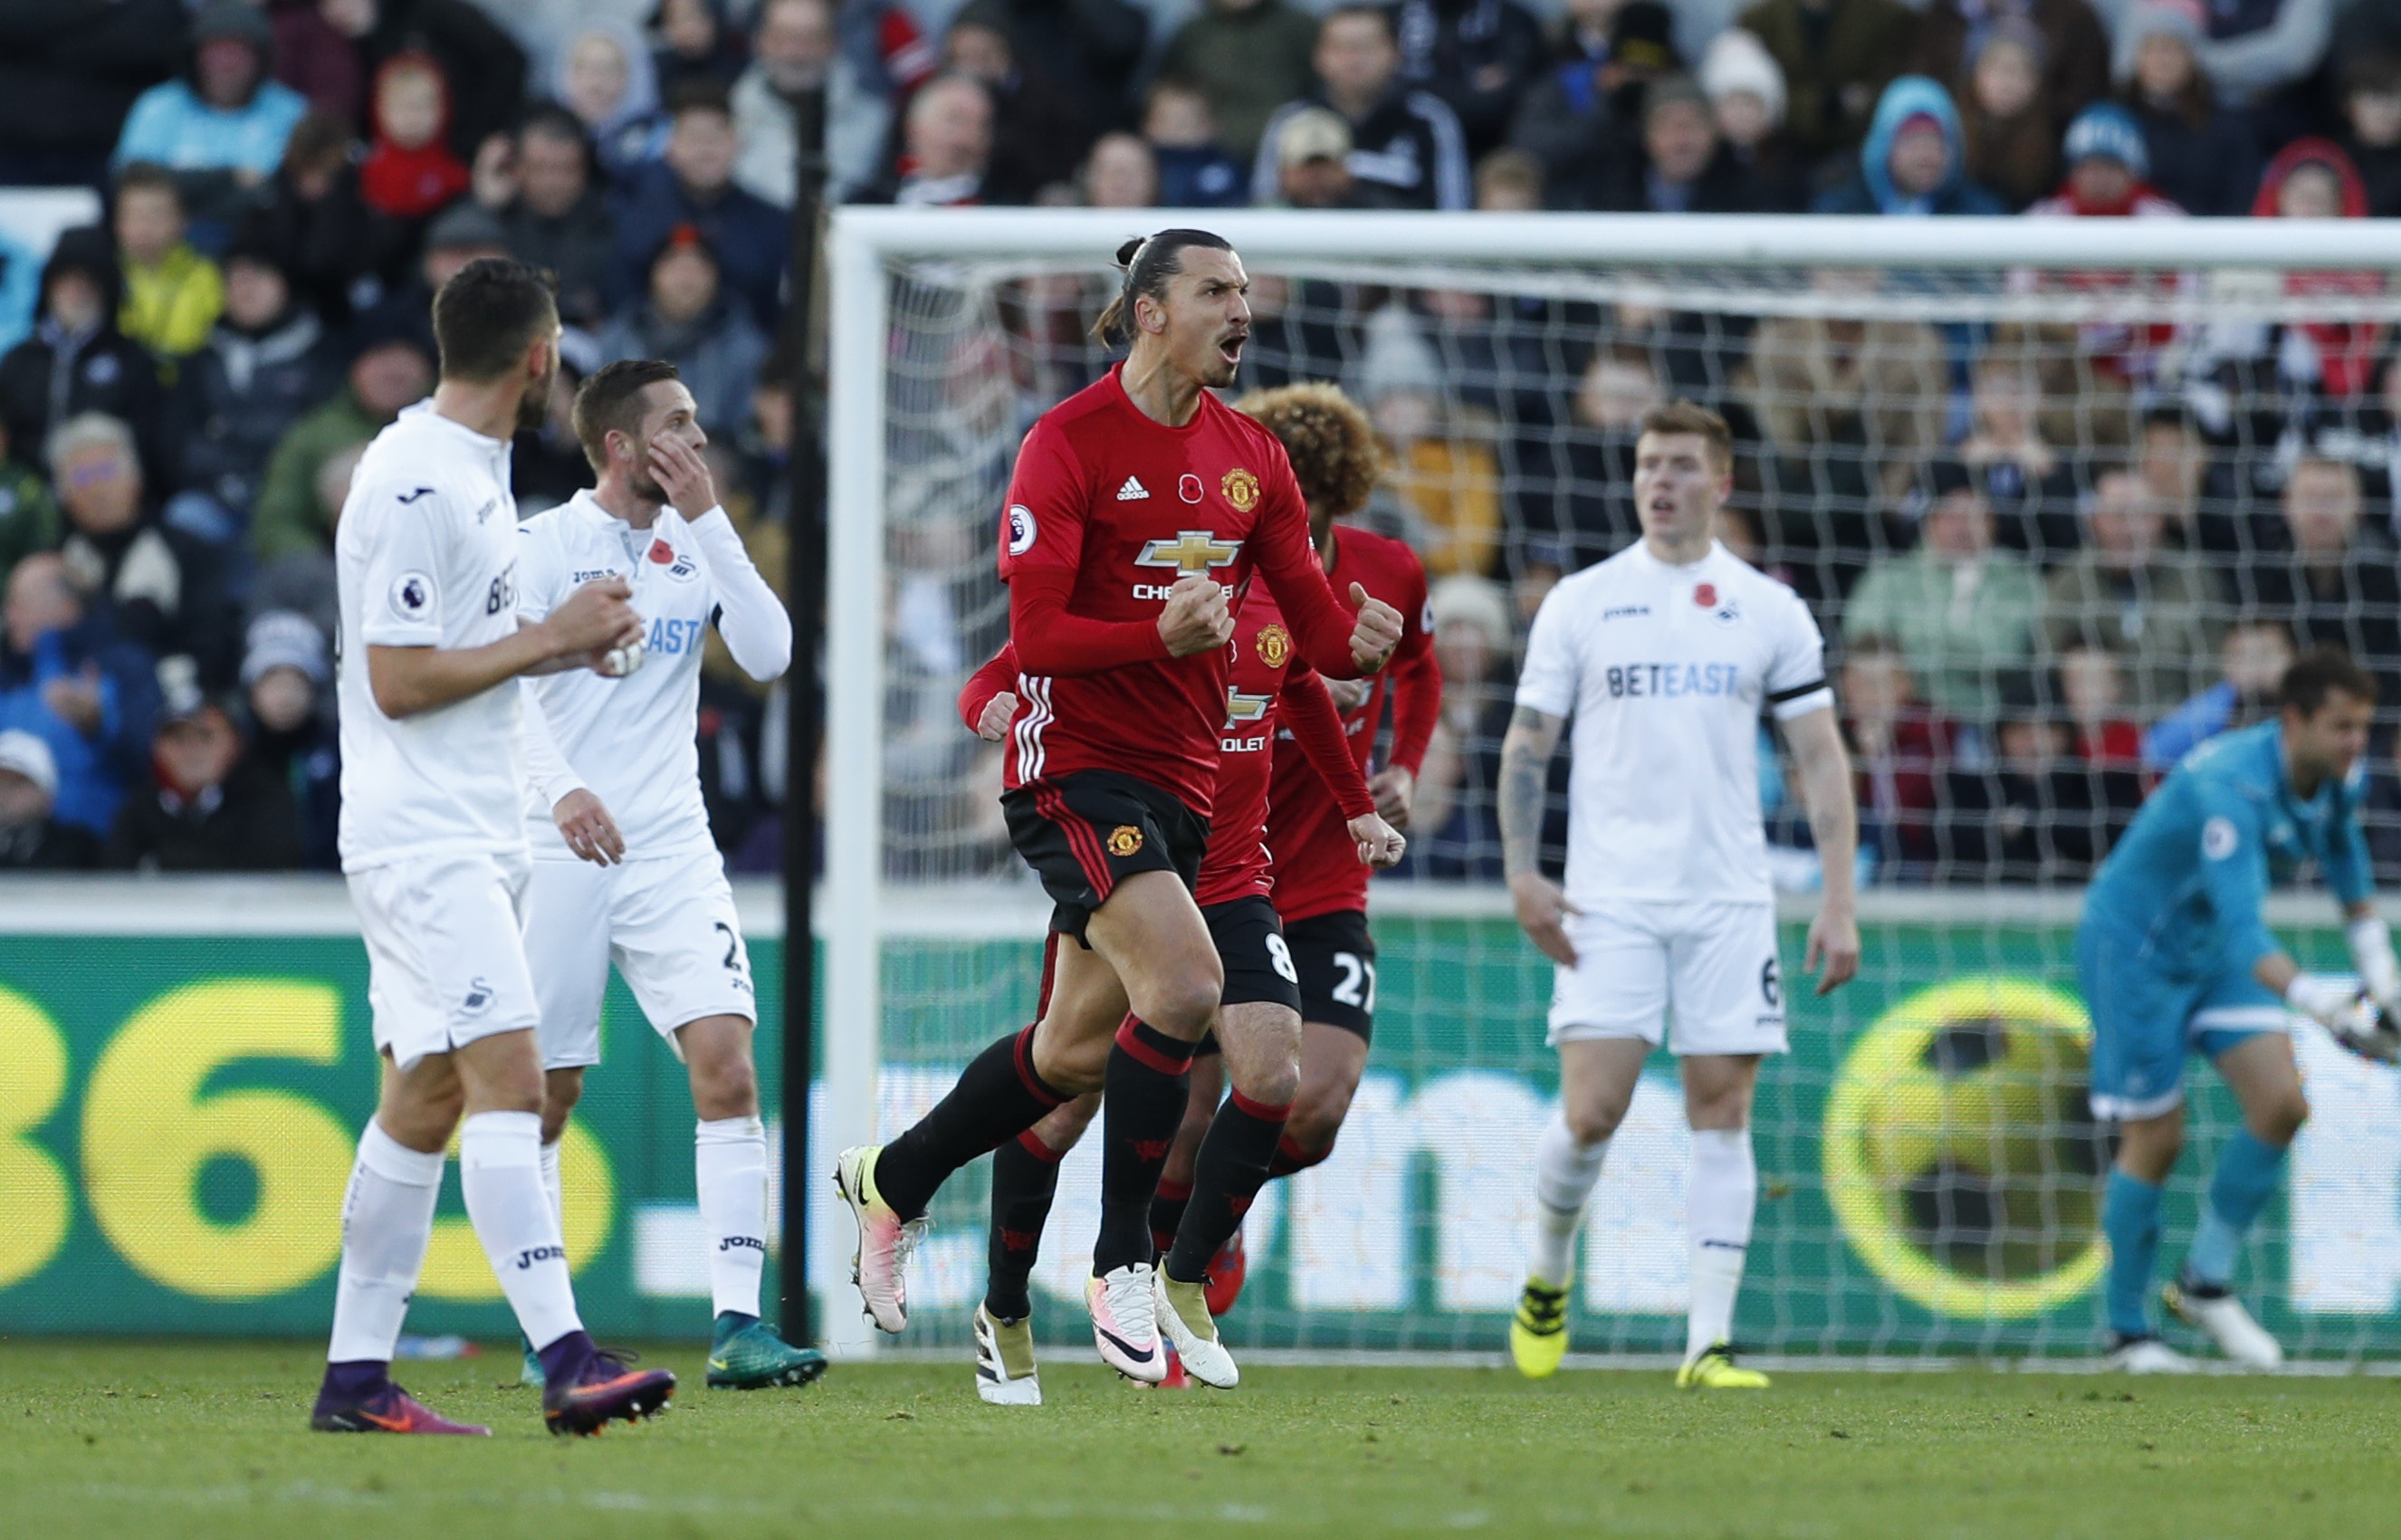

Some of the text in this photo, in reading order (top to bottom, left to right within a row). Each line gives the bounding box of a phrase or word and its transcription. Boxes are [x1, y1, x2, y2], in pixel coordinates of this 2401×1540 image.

[641, 618, 700, 655] AST
[1607, 664, 1738, 698] BETEAST
[1220, 737, 1266, 752] OLET
[1265, 933, 1298, 984] 8
[1332, 952, 1376, 1015] 21
